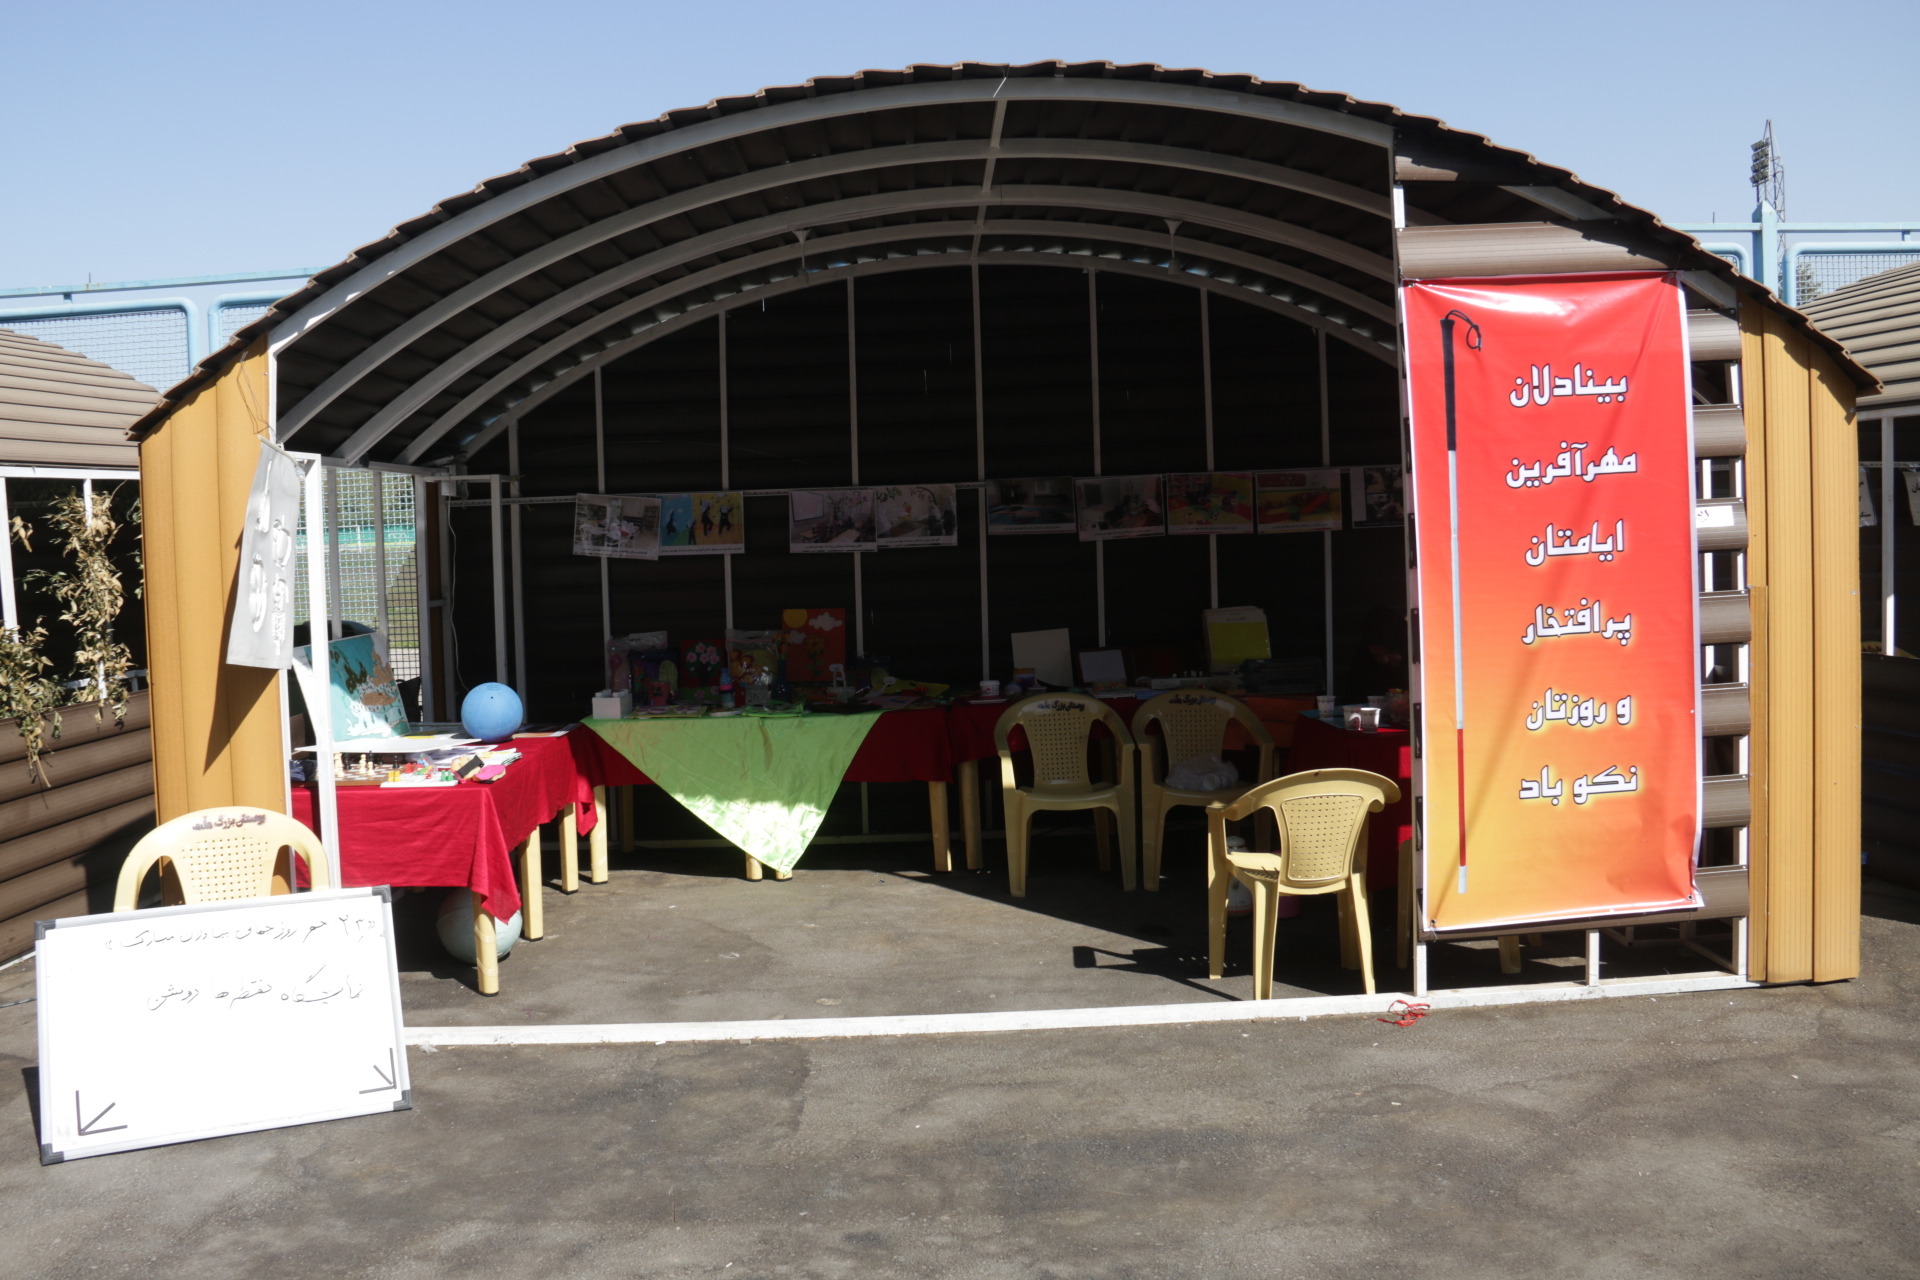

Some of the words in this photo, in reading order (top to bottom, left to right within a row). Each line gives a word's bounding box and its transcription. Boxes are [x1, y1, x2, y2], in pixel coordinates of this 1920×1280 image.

[1509, 362, 1628, 408] بینادلان
[1505, 440, 1638, 489] مهرآفرین
[1525, 518, 1625, 567] ایامتان
[1521, 597, 1632, 646] پرافتخار
[1525, 687, 1607, 731] روزتان
[1616, 694, 1632, 726] و
[1518, 764, 1563, 807] باد
[1572, 764, 1638, 805] نکو
[280, 963, 364, 1005] نمایشگاه
